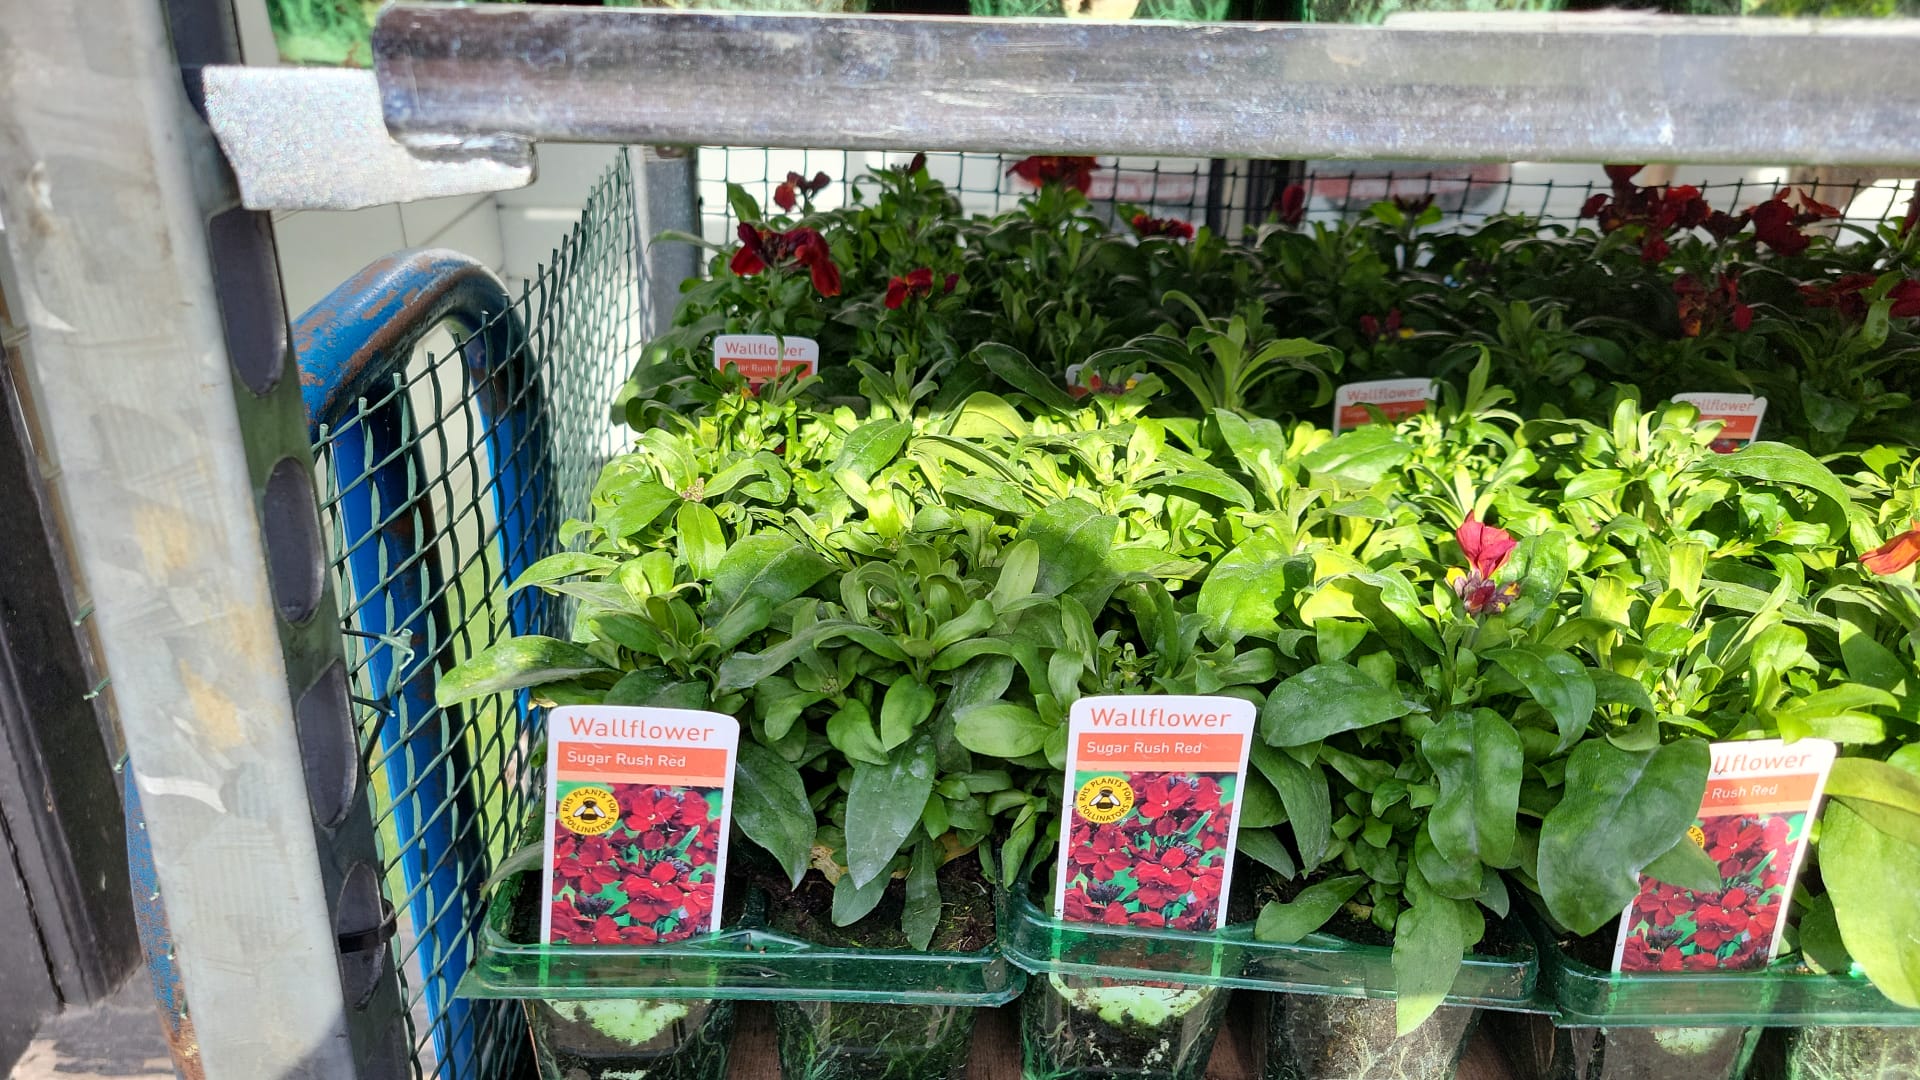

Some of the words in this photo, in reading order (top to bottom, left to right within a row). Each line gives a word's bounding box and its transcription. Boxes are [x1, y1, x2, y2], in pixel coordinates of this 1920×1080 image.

[1347, 387, 1425, 400] Wallflower
[1091, 708, 1232, 727] Wallflower
[569, 716, 715, 742] Wallflower
[1087, 741, 1129, 757] Sugar
[1134, 741, 1170, 754] Rush
[1174, 742, 1202, 754] Red
[567, 751, 612, 767] Sugar
[616, 753, 654, 766] Rush
[658, 755, 687, 768] Red
[1080, 787, 1091, 801] RHS
[1090, 778, 1124, 788] PLANTS
[1122, 787, 1132, 801] FOR
[1712, 787, 1747, 800] Rush
[1751, 784, 1779, 796] Red
[562, 797, 574, 812] RHS
[573, 789, 607, 799] PLANTS
[607, 799, 617, 813] FOR
[1081, 804, 1130, 821] POLLINATORS
[564, 815, 615, 833] POLLINATORS
